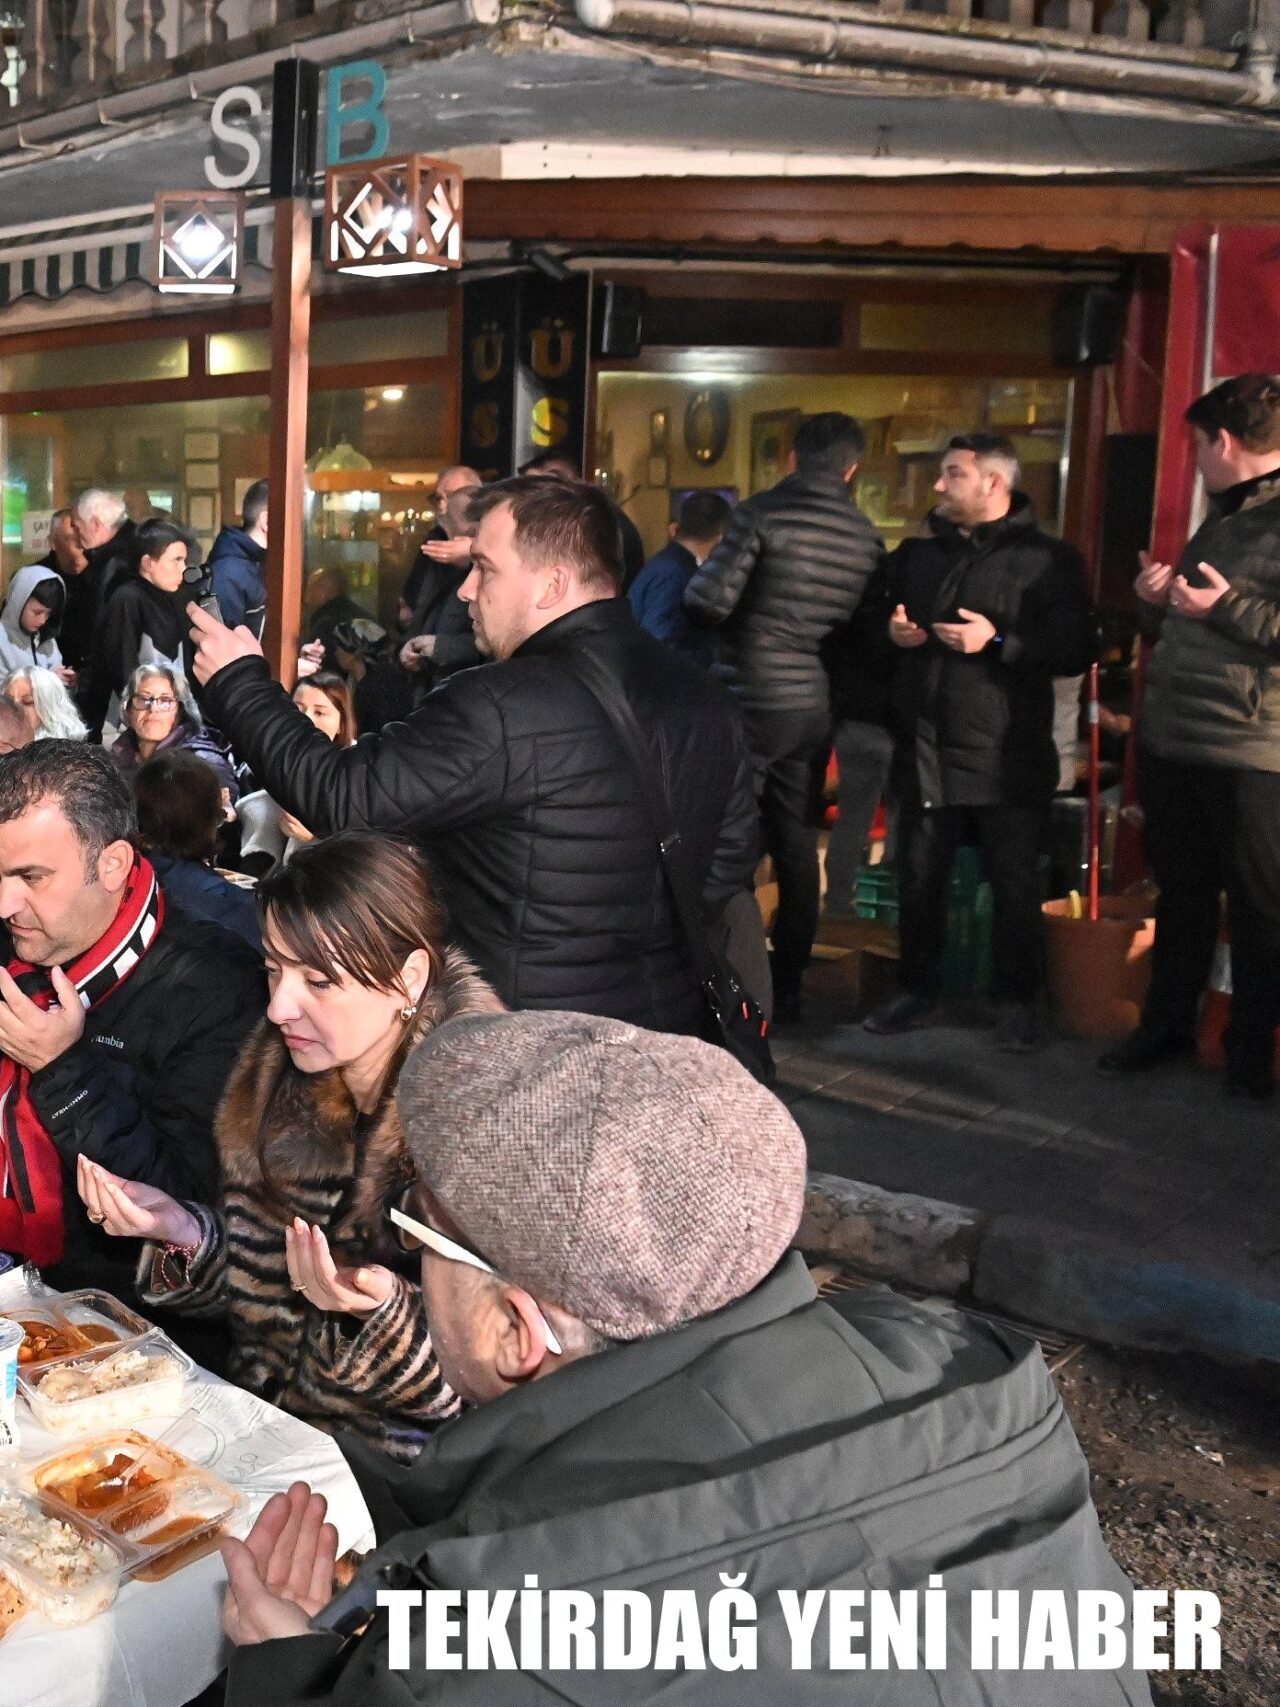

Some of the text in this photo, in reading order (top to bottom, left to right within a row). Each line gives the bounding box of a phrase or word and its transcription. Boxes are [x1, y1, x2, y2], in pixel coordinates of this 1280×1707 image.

[203, 85, 262, 189] S
[325, 60, 392, 165] B
[530, 319, 576, 449] ÜS
